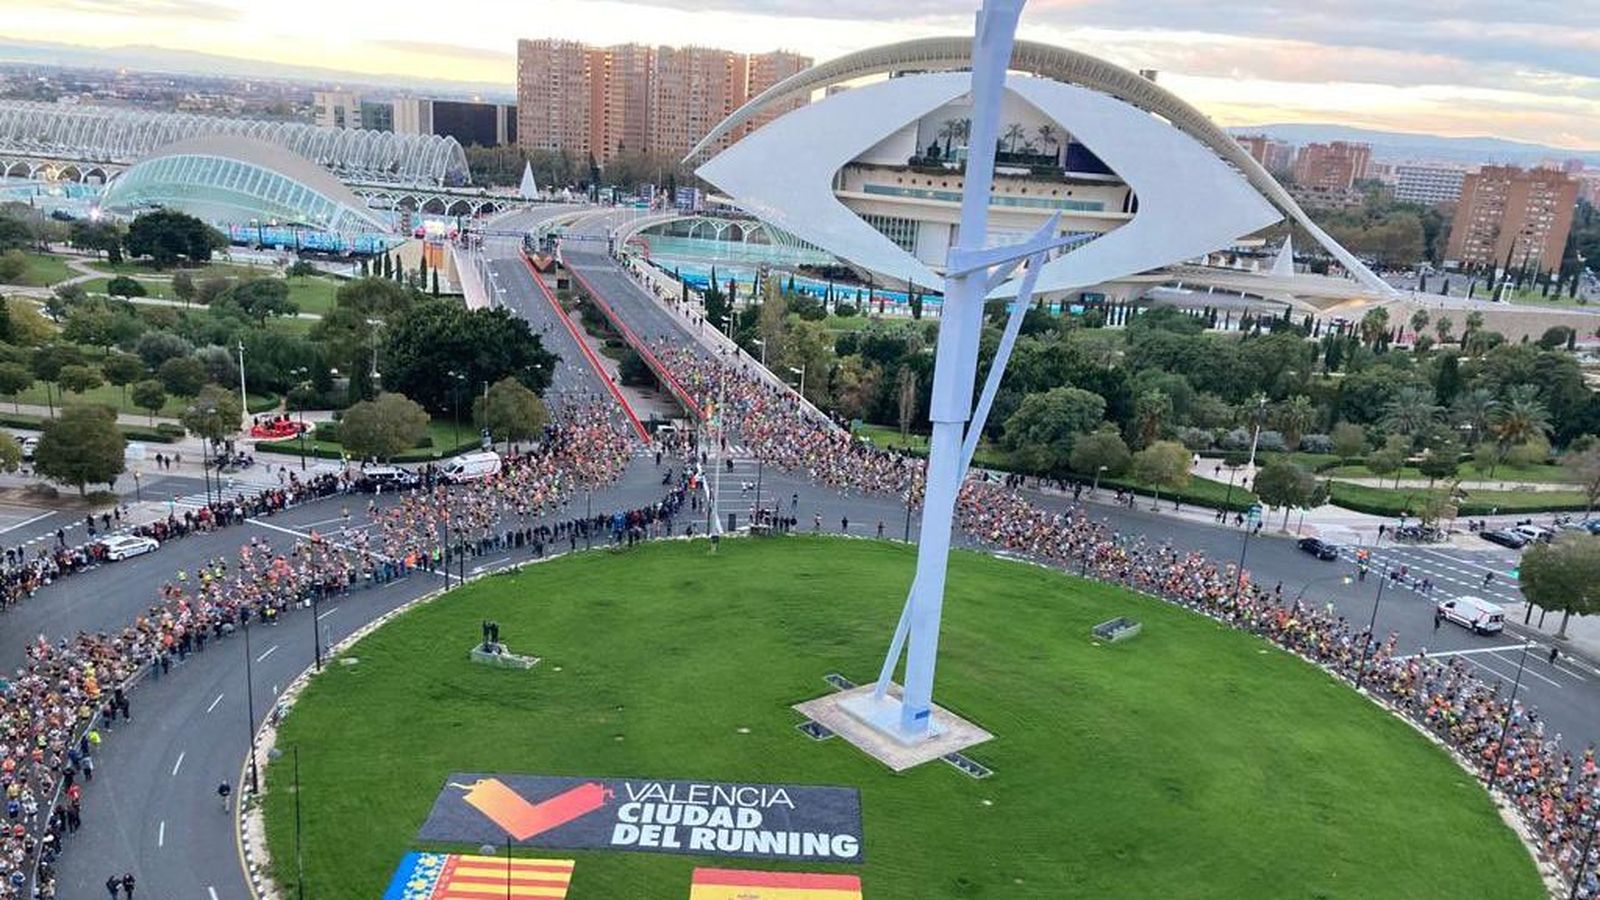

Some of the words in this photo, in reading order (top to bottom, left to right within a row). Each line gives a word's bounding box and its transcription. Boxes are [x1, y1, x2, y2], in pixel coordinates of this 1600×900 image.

[625, 782, 796, 809] VALENCIA
[618, 802, 763, 829] CIUDAD
[611, 823, 681, 848] DEL
[690, 827, 859, 857] RUNNING
